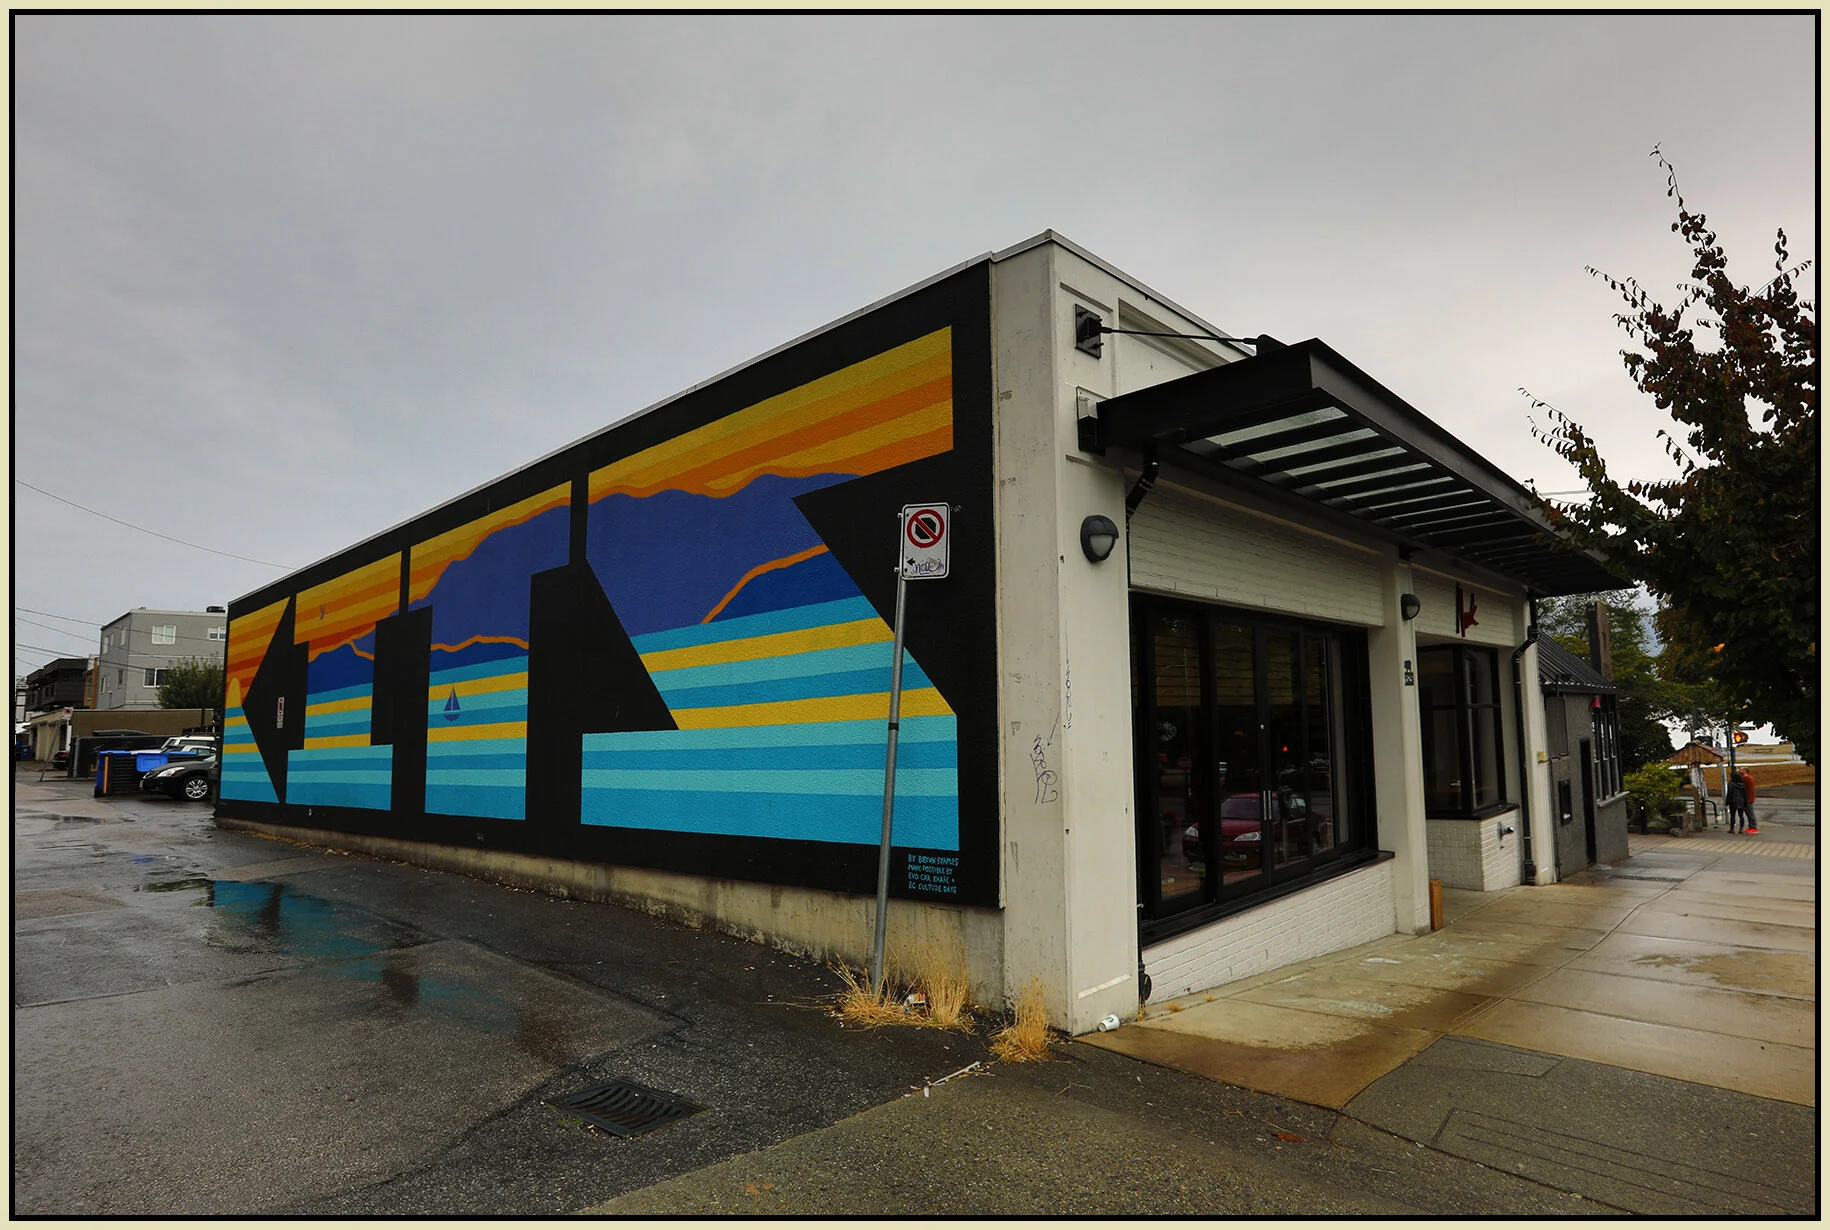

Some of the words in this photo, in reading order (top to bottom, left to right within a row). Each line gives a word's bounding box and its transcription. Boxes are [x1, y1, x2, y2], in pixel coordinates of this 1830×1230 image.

[937, 857, 959, 867] STAPLES
[920, 873, 931, 881] CAR
[918, 883, 942, 892] CULTURE
[943, 886, 957, 894] DAYS
